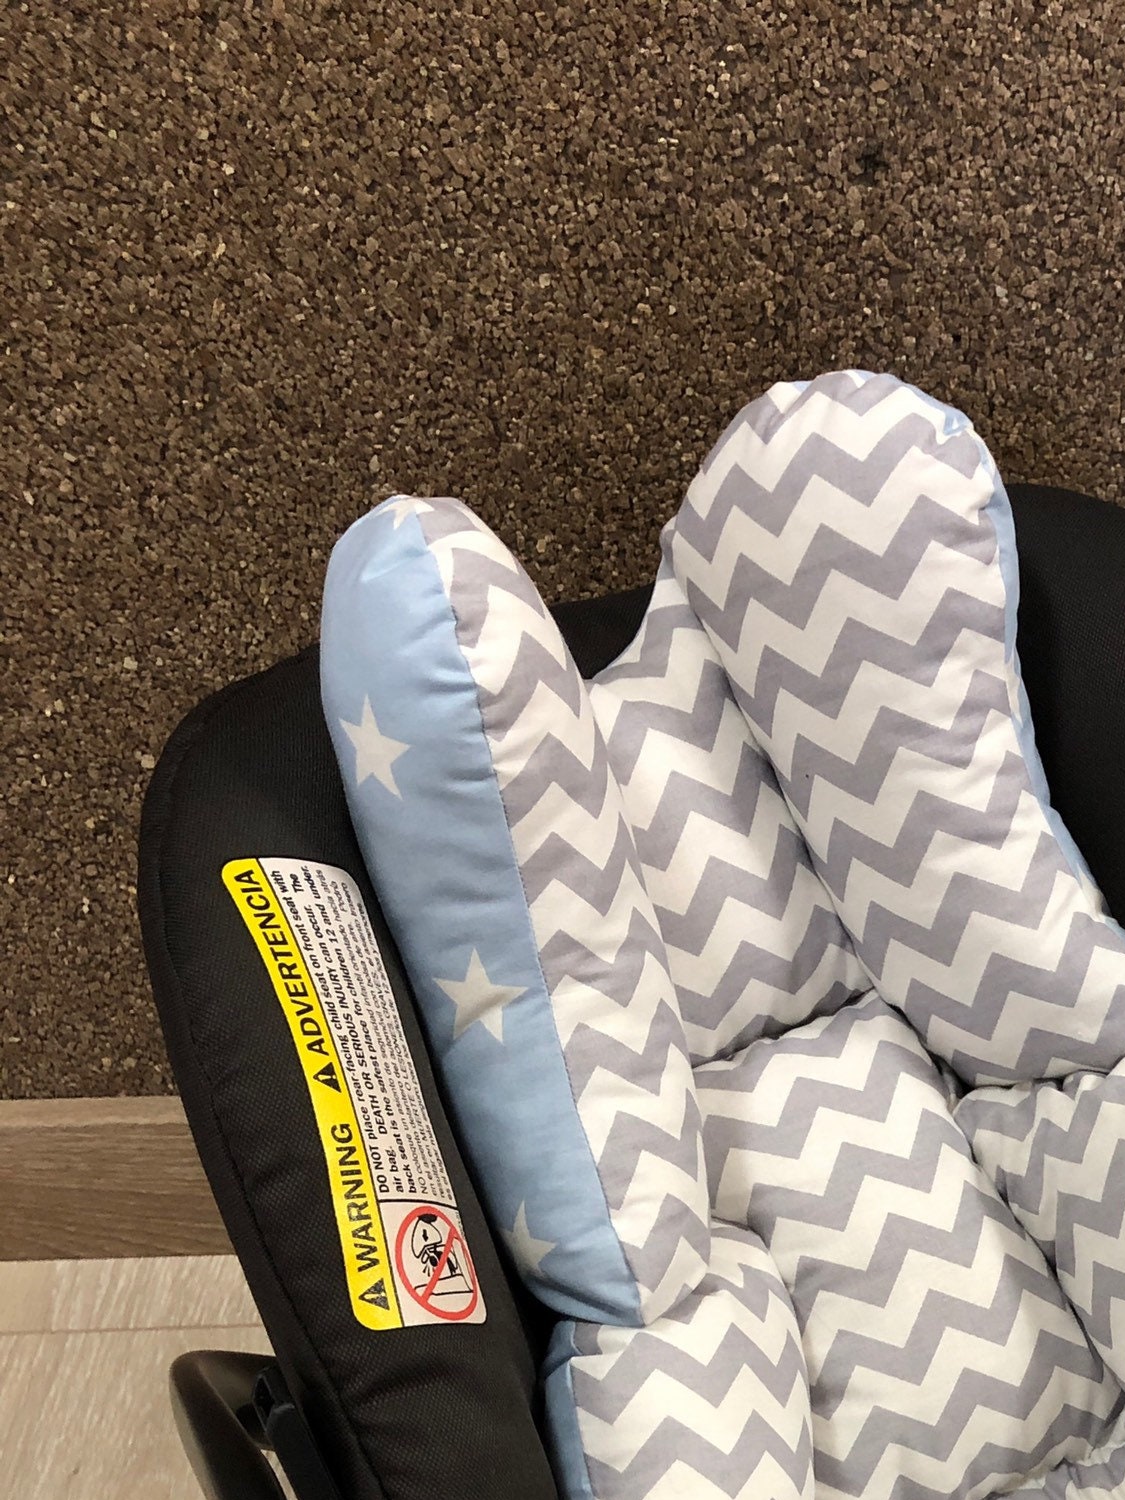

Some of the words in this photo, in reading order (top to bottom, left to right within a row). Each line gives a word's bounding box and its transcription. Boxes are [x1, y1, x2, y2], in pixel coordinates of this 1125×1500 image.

[270, 870, 288, 893] with
[289, 873, 304, 893] The
[300, 865, 321, 899] under.
[282, 896, 301, 921] seat
[303, 904, 323, 938] occur.
[314, 903, 331, 925] and
[294, 923, 314, 951] front
[325, 928, 338, 943] 12
[233, 869, 329, 1056] ADVERTENCIA
[308, 954, 320, 968] on
[318, 942, 333, 963] can
[314, 972, 332, 998] seat
[334, 948, 357, 996] children
[325, 966, 349, 1009] INJURY
[324, 1000, 342, 1030] child
[352, 998, 363, 1016] for
[342, 1013, 367, 1067] SERIOUS
[359, 1019, 377, 1052] place
[336, 1034, 365, 1102] rear-facing
[361, 1071, 374, 1090] OR
[369, 1055, 387, 1093] safest
[368, 1094, 387, 1134] DEATH
[382, 1096, 394, 1116] the
[360, 1106, 378, 1139] place
[389, 1119, 398, 1130] is
[368, 1144, 384, 1170] NOT
[384, 1146, 399, 1172] bag.
[392, 1133, 407, 1159] seat
[376, 1174, 389, 1193] DO
[392, 1176, 404, 1193] air
[402, 1164, 417, 1193] back
[417, 1176, 428, 1194] NO
[330, 1123, 380, 1272] WARNING
